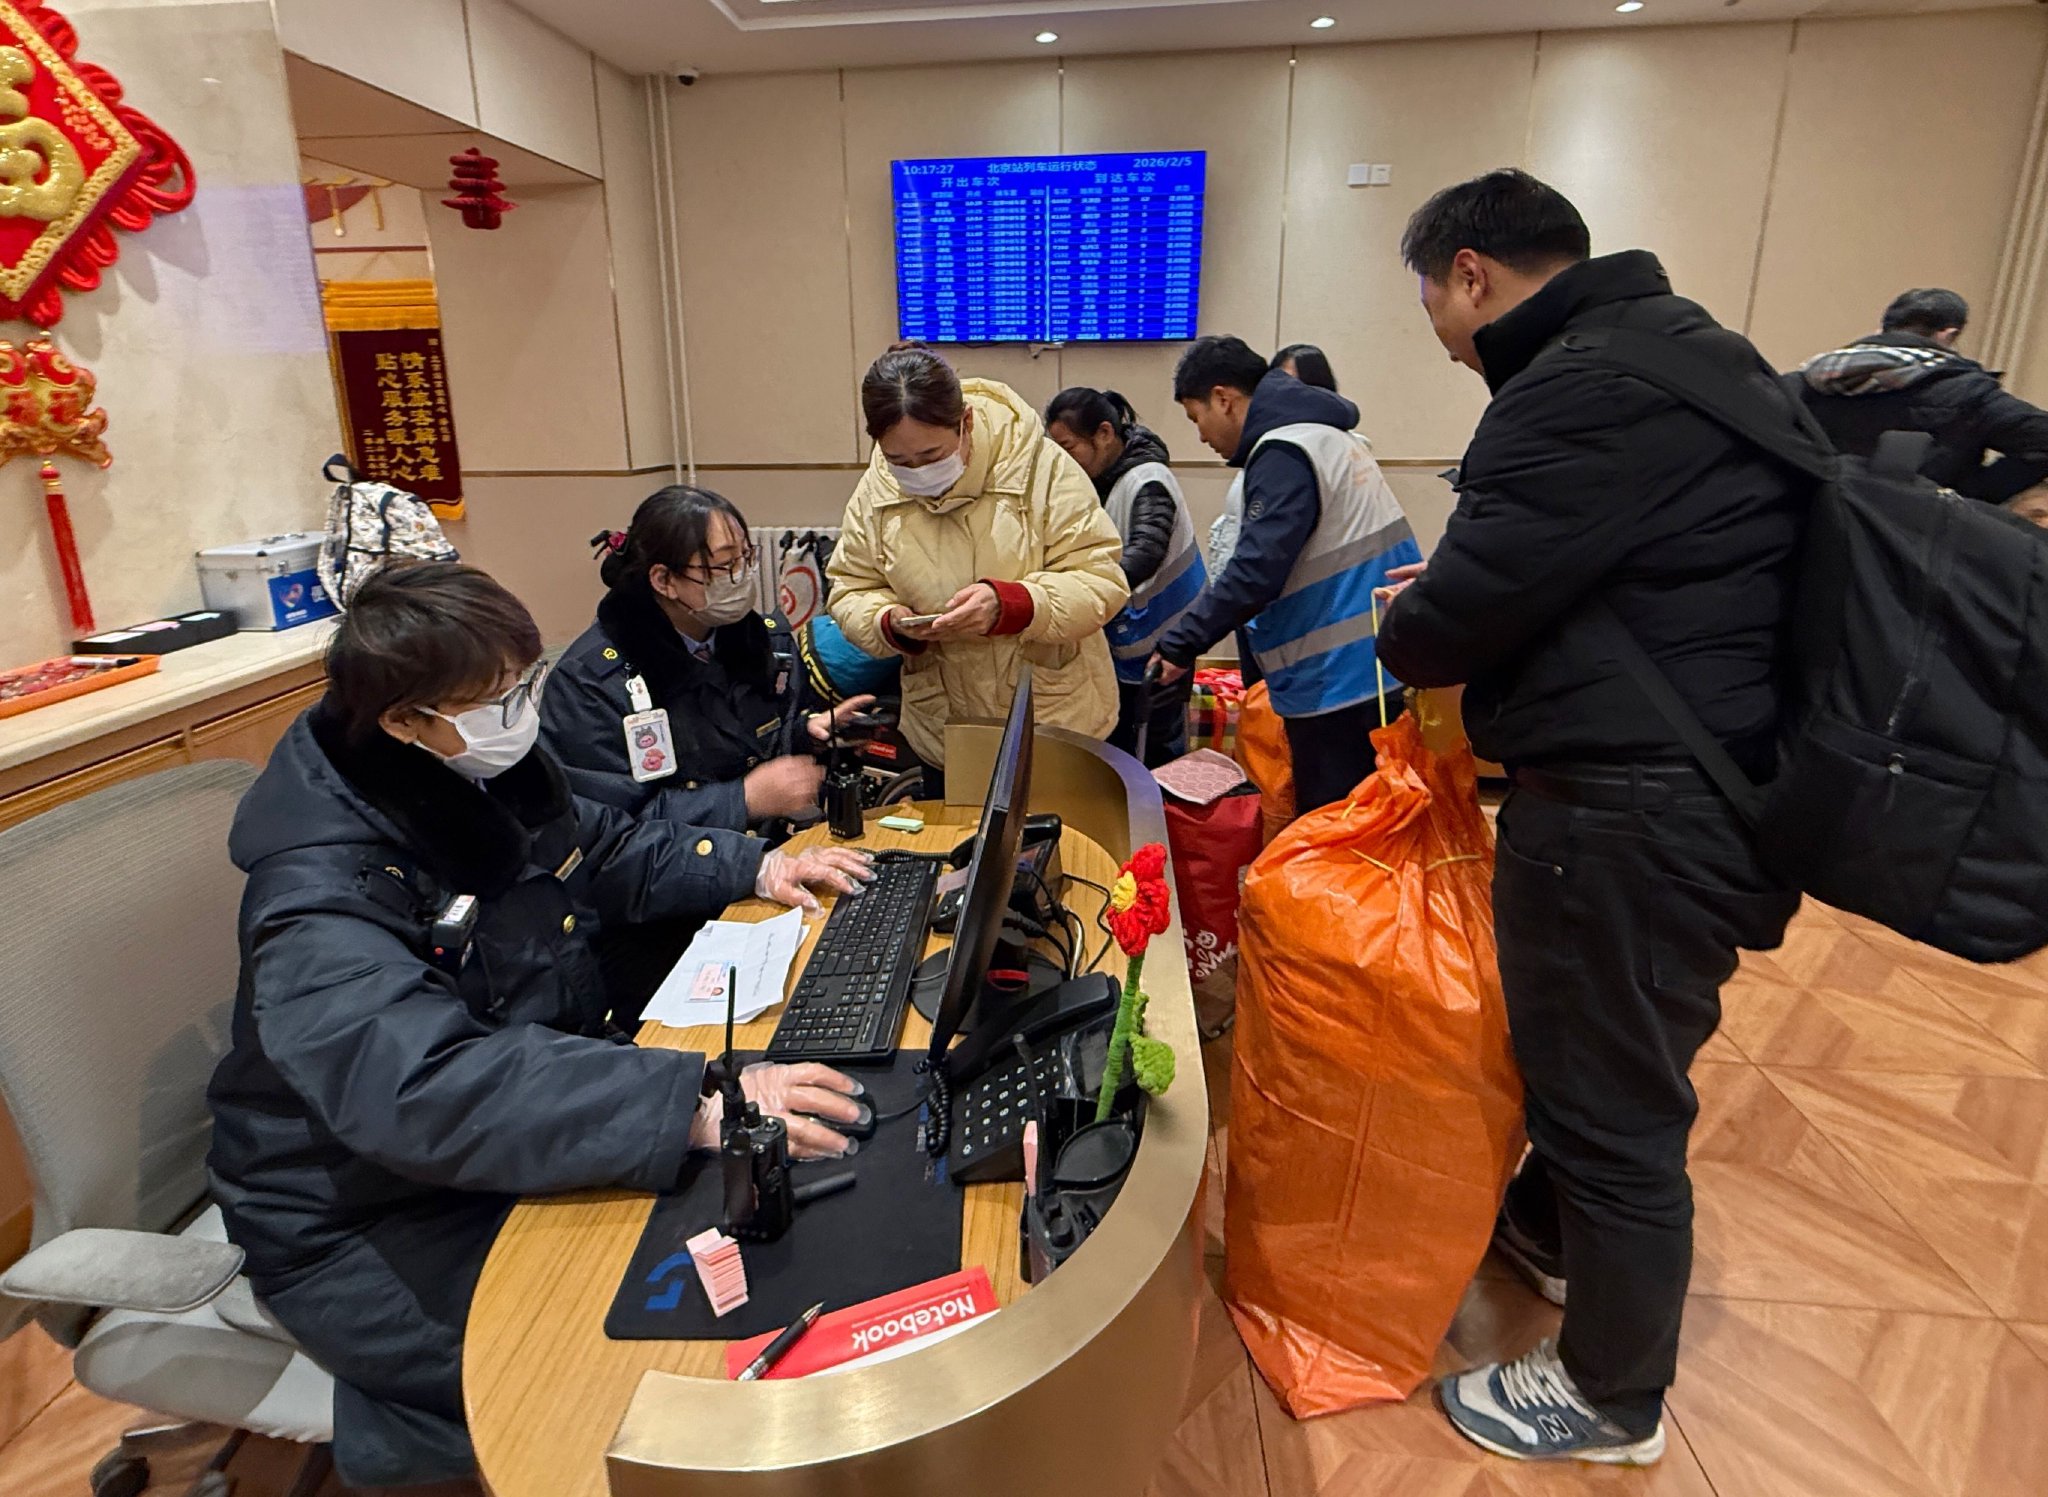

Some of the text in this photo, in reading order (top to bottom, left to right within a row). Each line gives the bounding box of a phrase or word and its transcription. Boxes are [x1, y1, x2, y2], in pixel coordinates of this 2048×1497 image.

[987, 160, 1097, 173] 北京站列车运行状态
[1133, 157, 1192, 168] 2026/2/5
[903, 164, 954, 175] 10:17:27
[941, 177, 1000, 188] 开出车次
[1094, 172, 1156, 184] 到达车次
[1016, 1081, 1026, 1090] 5
[999, 1090, 1008, 1100] 8
[1017, 1098, 1027, 1107] 6
[999, 1107, 1009, 1117] 9
[851, 1293, 976, 1352] Notebook
